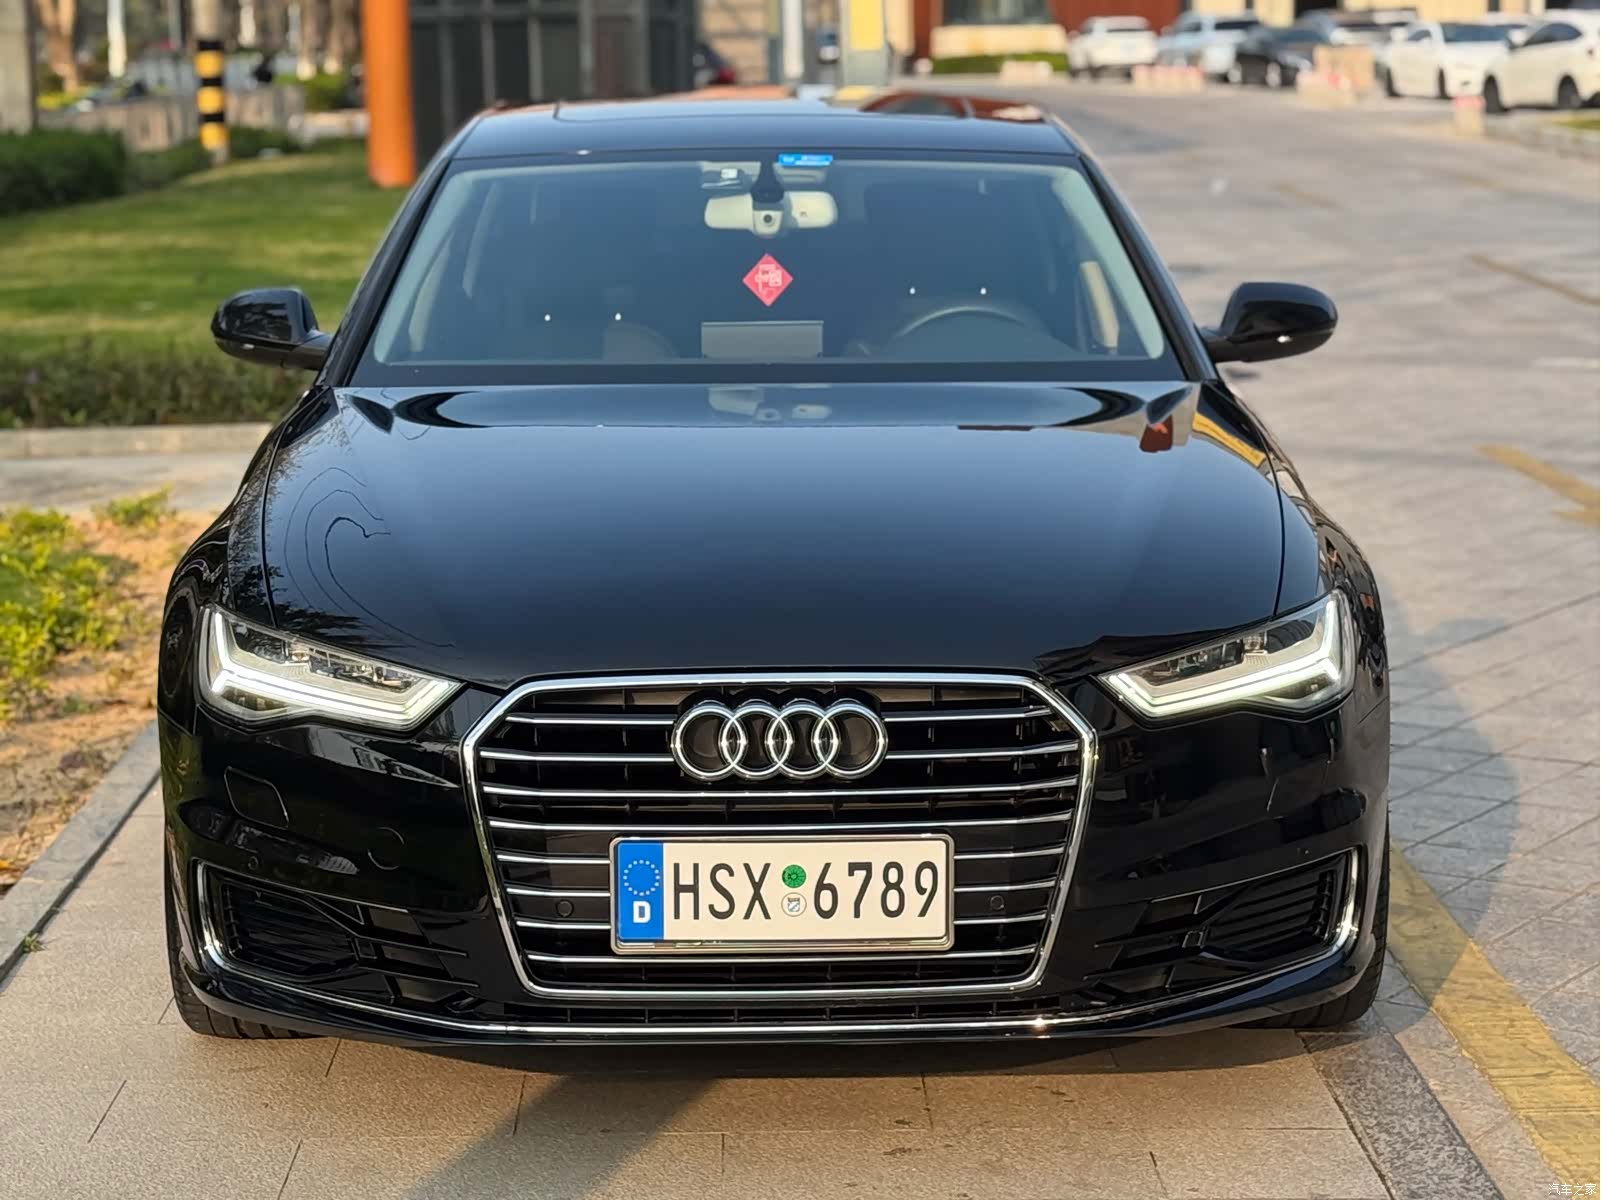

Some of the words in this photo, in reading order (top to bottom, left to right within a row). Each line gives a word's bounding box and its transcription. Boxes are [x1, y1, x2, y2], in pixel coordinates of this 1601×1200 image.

[673, 862, 771, 920] HSX
[813, 861, 938, 919] 6789
[632, 900, 651, 923] D
